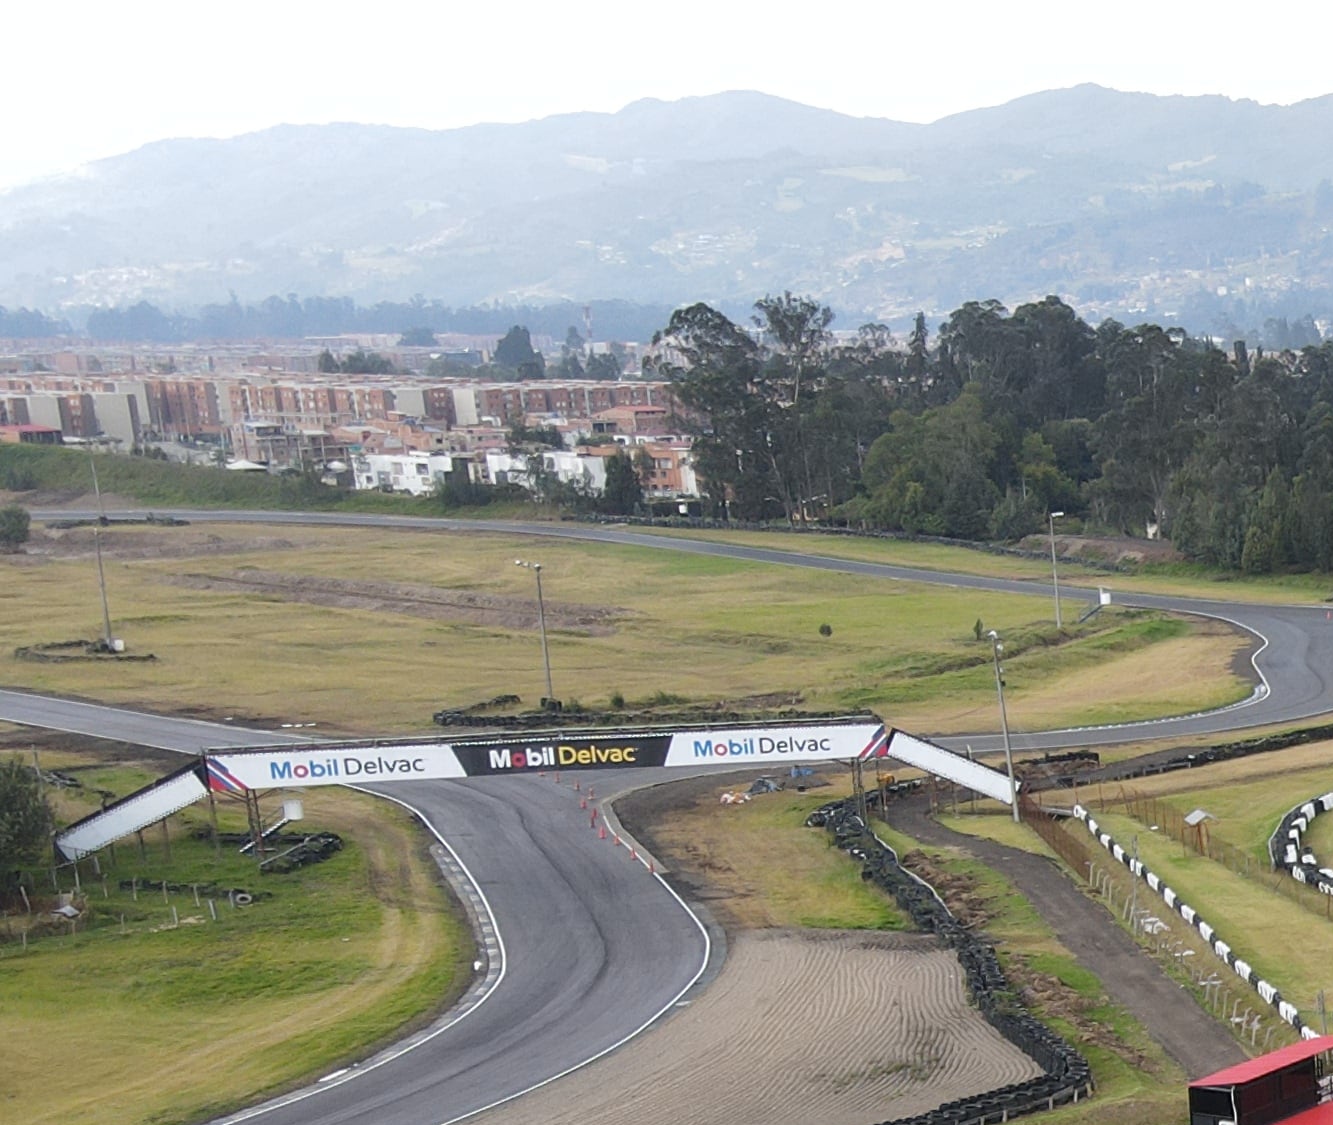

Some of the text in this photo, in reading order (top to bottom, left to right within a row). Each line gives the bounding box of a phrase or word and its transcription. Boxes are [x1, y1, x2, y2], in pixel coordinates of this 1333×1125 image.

[489, 745, 636, 769] Mobil Delvac
[693, 736, 832, 758] Mobil Delvac
[270, 756, 425, 780] Mobil Delvac
